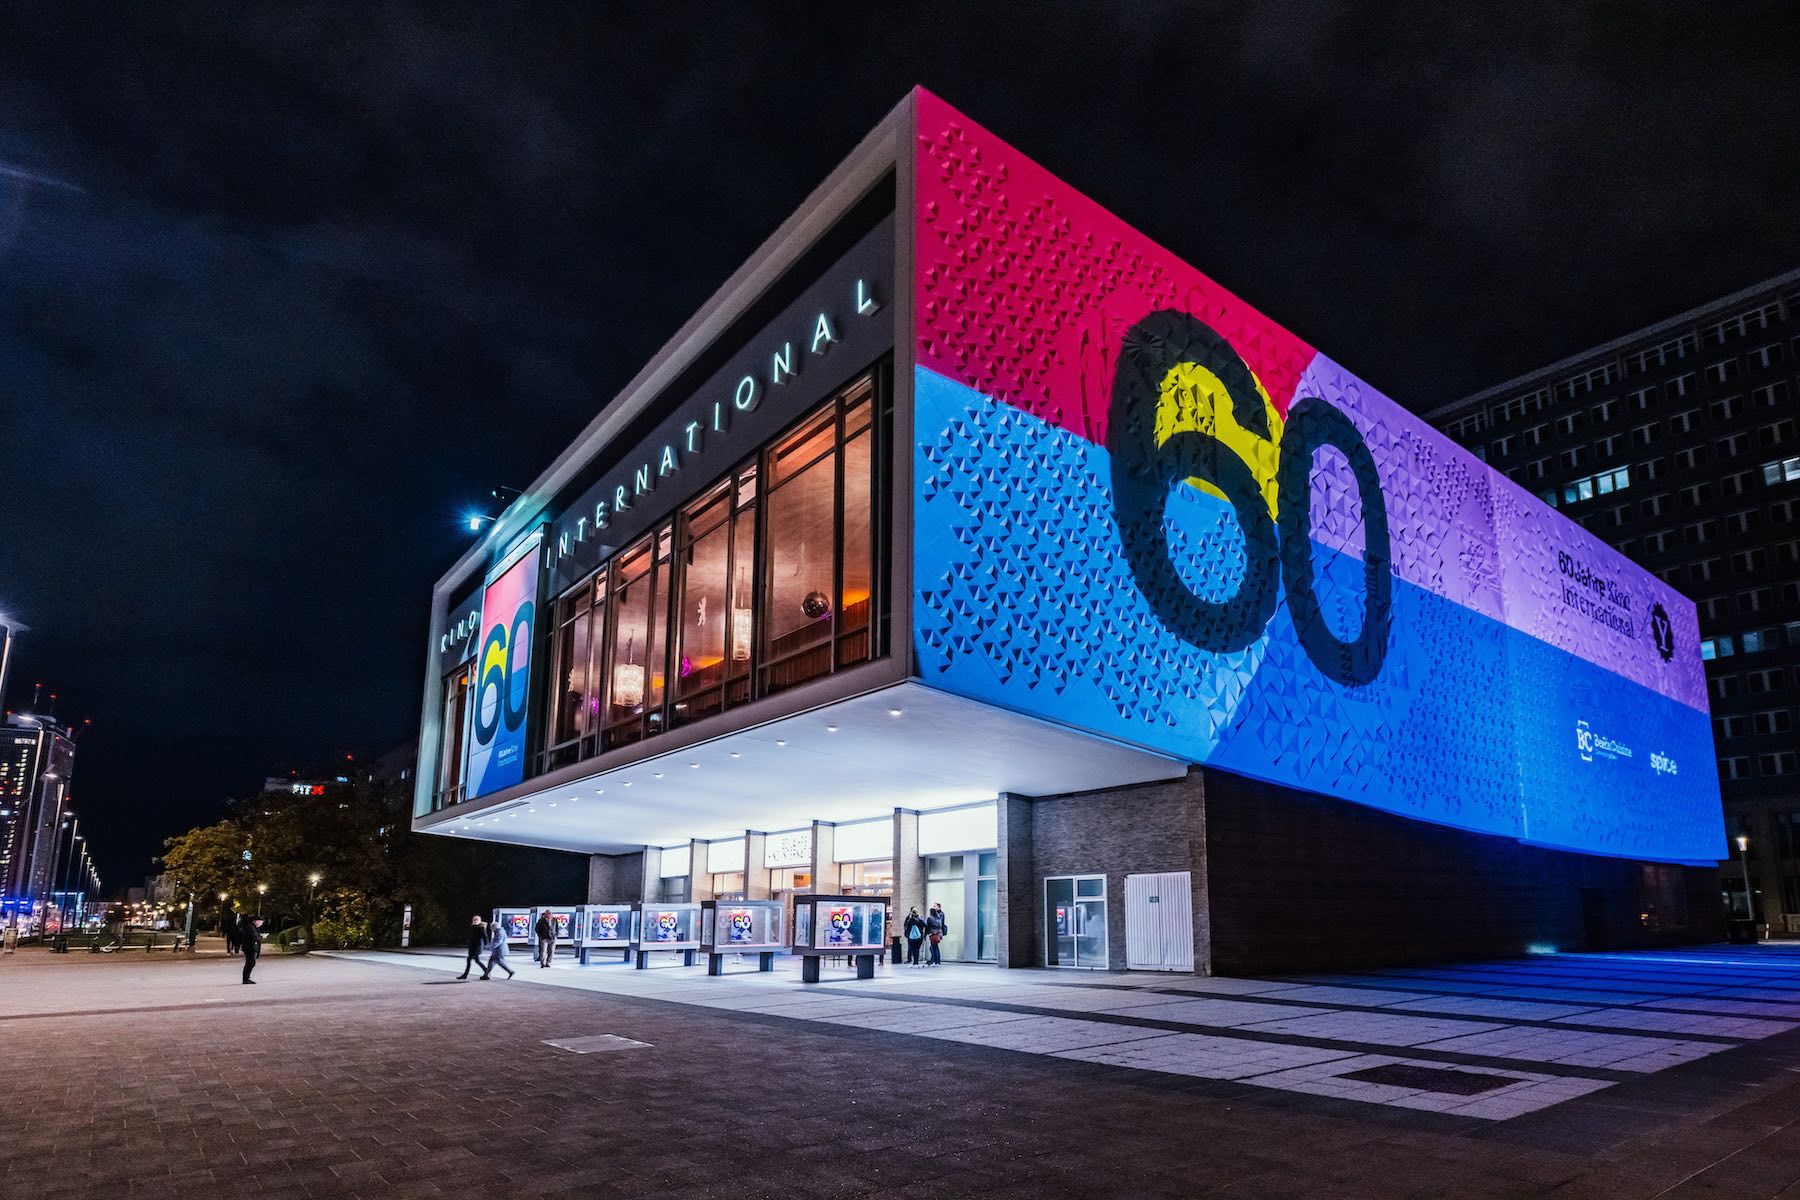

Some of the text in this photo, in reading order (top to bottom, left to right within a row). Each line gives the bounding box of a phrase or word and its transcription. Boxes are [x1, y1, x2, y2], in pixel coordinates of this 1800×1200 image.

[546, 279, 874, 569] INTERNATIONAL
[1106, 309, 1392, 686] 60
[1558, 550, 1574, 578] 60
[1575, 561, 1606, 598] Jahre
[440, 610, 478, 653] KINO
[1560, 579, 1635, 640] International
[475, 600, 535, 746] 60
[1576, 728, 1593, 753] BC
[1649, 750, 1678, 776] spice
[831, 913, 851, 929] 60
